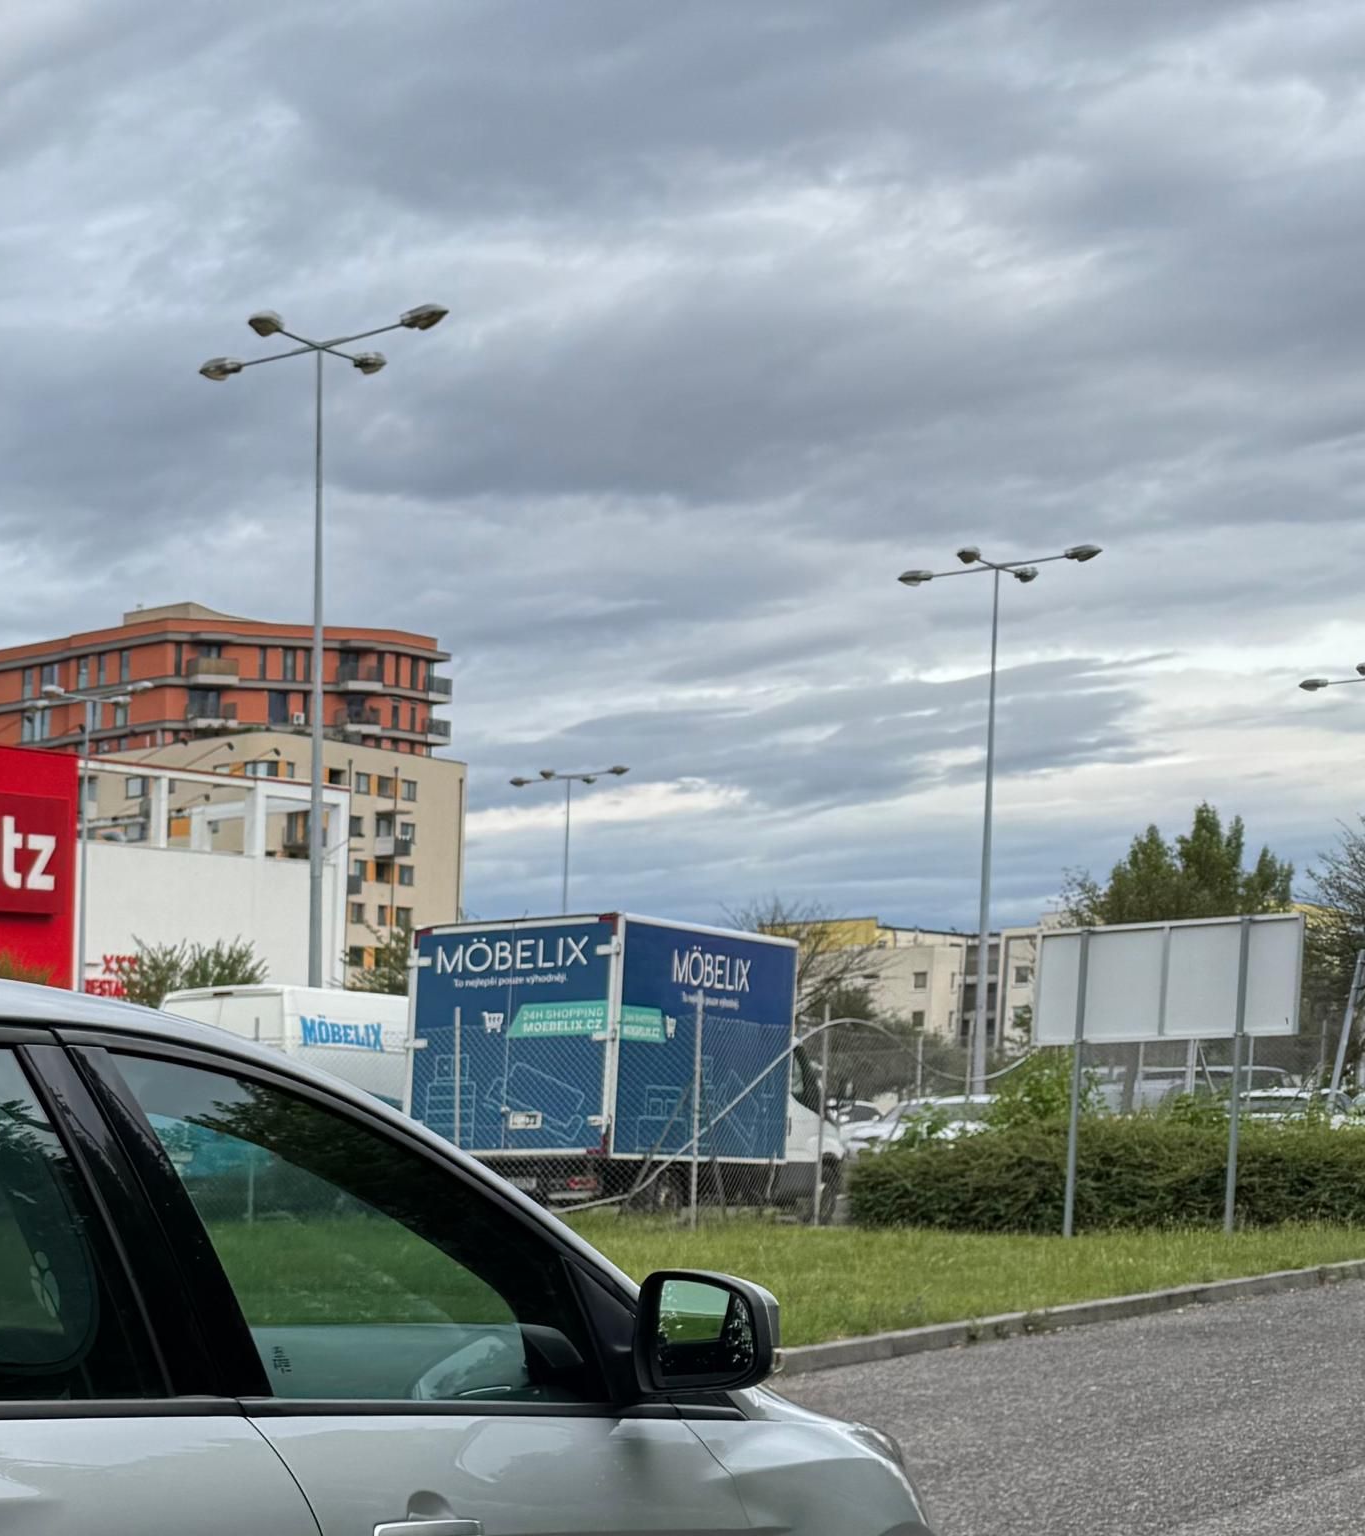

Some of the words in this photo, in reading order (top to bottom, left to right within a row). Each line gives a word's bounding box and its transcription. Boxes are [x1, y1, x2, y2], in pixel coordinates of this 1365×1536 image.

[436, 935, 589, 975] MÖBELIX
[672, 945, 751, 993] MÖBELIX
[300, 1014, 385, 1053] MÖBELIX
[523, 1010, 543, 1021] 24H
[546, 1007, 604, 1020] SHOPPING
